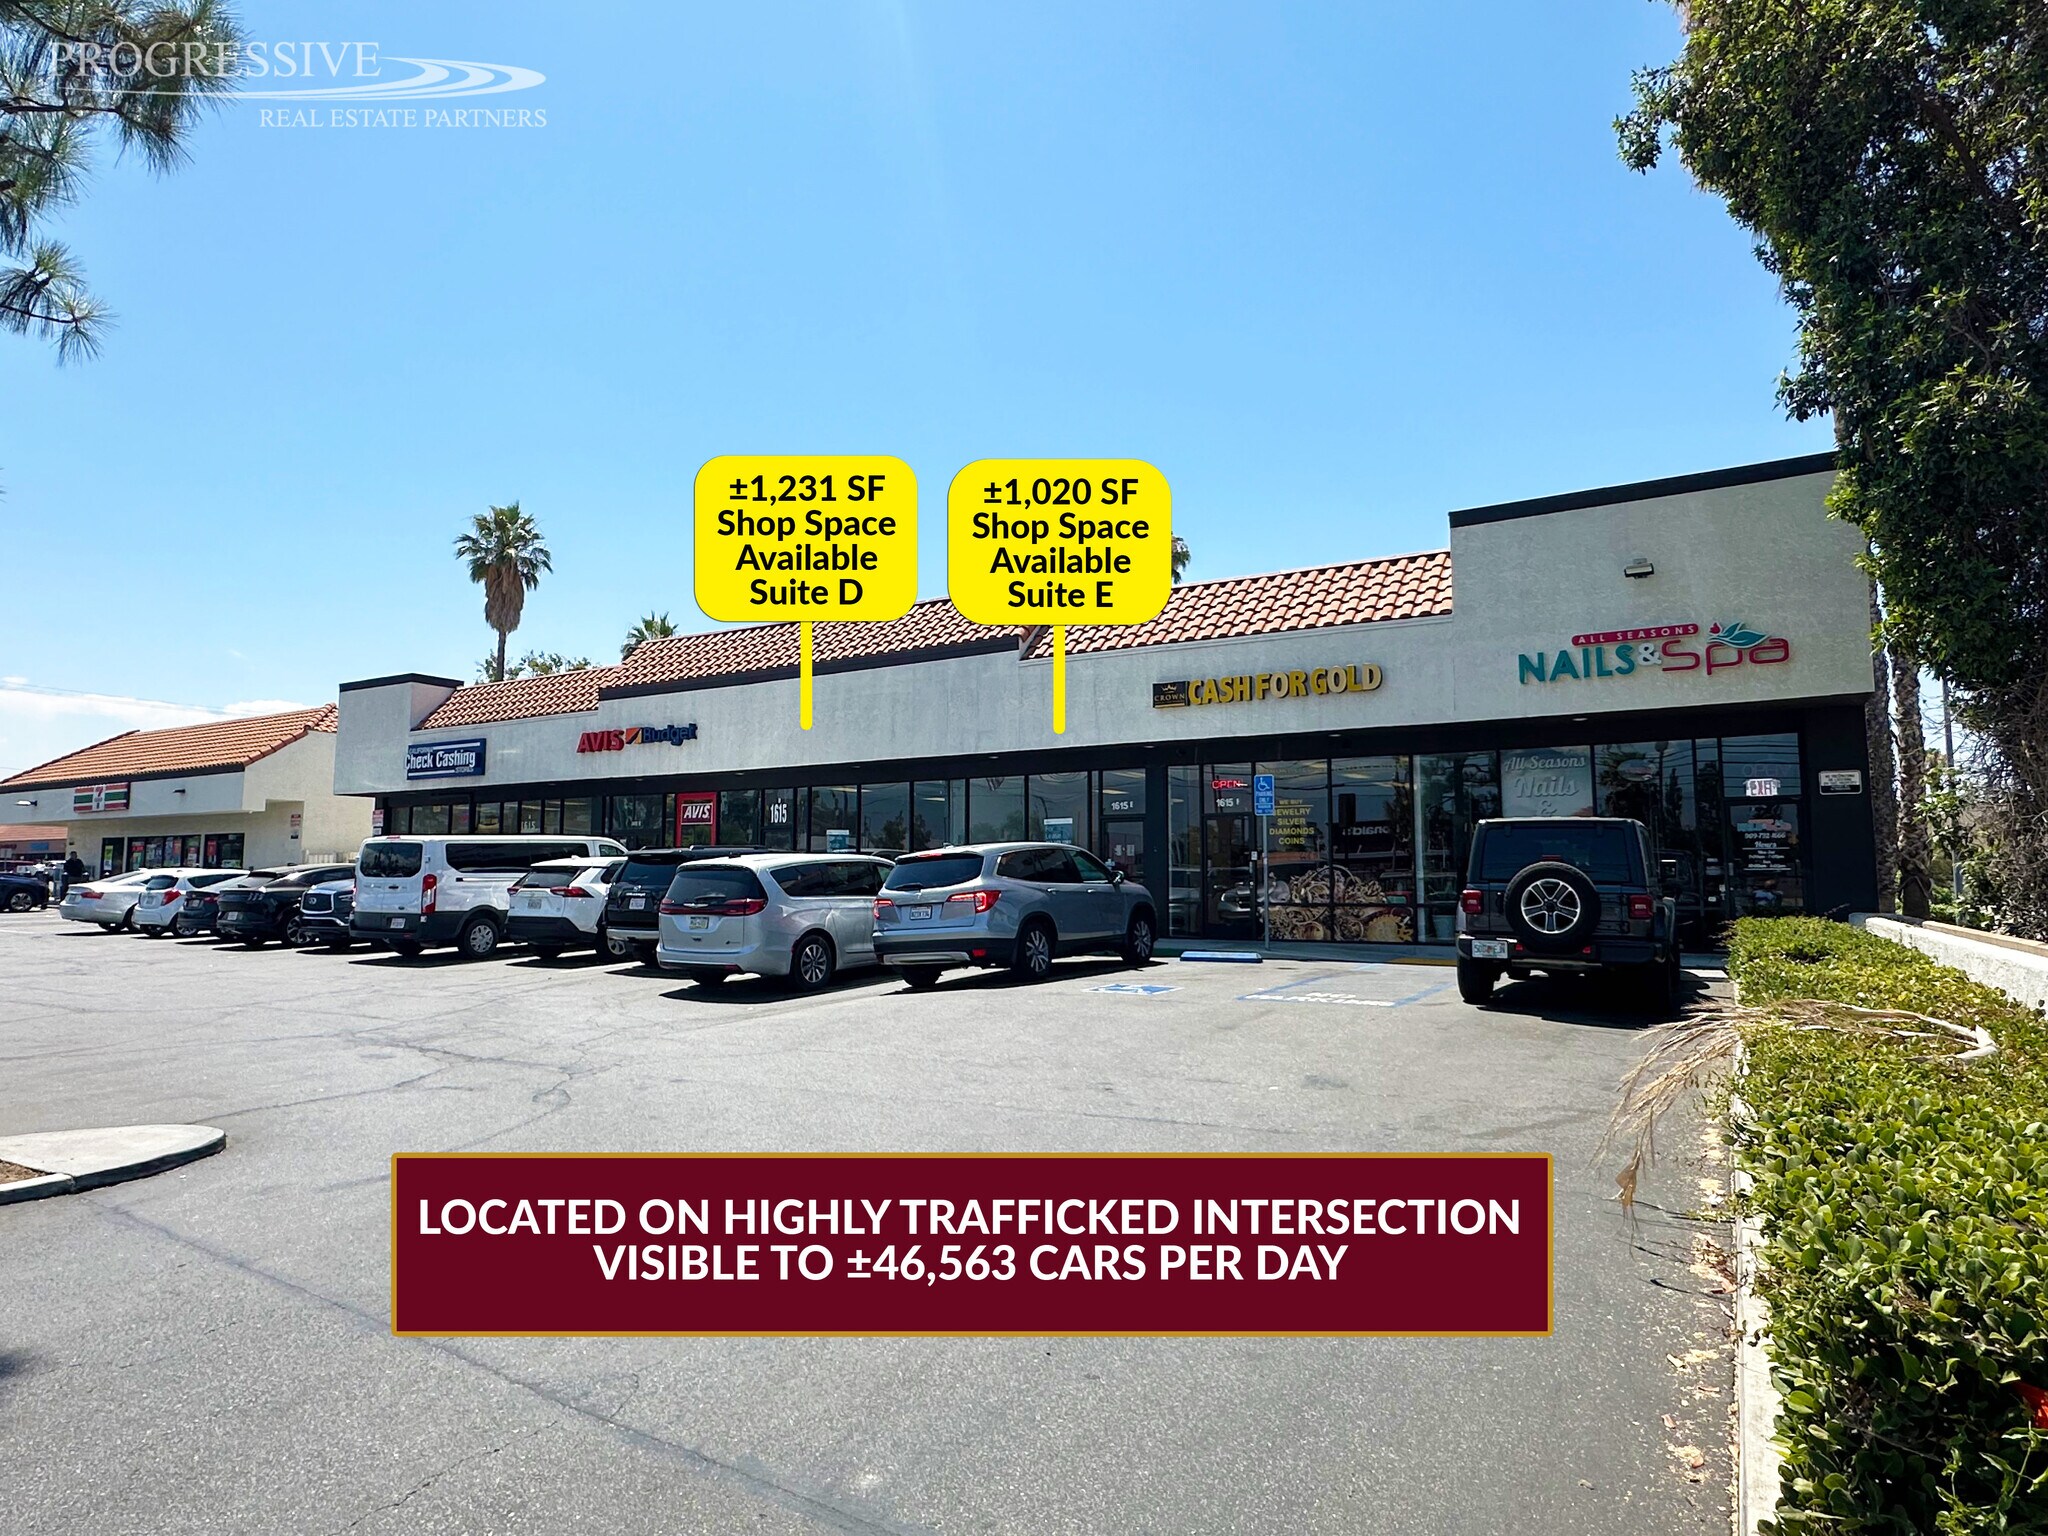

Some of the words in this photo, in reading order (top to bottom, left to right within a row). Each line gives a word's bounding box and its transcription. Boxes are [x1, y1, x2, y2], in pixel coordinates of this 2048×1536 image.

[1577, 634, 1606, 645] ALL
[1616, 624, 1696, 642] SEASONS
[1517, 644, 1636, 685] NAILS
[1638, 642, 1662, 666] &
[1661, 637, 1791, 676] Spa
[1188, 676, 1253, 705] CASH
[1255, 668, 1309, 700] FOR
[1309, 662, 1382, 695] GOLD
[1154, 693, 1185, 702] CROWN
[576, 728, 626, 754] AVIS
[641, 722, 698, 747] Budget
[404, 751, 434, 770] Check
[436, 749, 476, 768] Cashing
[1528, 755, 1586, 769] Seasons
[1514, 775, 1580, 798] Nails
[684, 804, 711, 819] AVIS
[1111, 801, 1129, 811] 1615
[1216, 798, 1234, 808] 1615
[770, 803, 788, 824] 1615
[1277, 817, 1306, 826] SILVER
[1269, 827, 1315, 836] DIAMONDS
[1278, 836, 1306, 845] COINS
